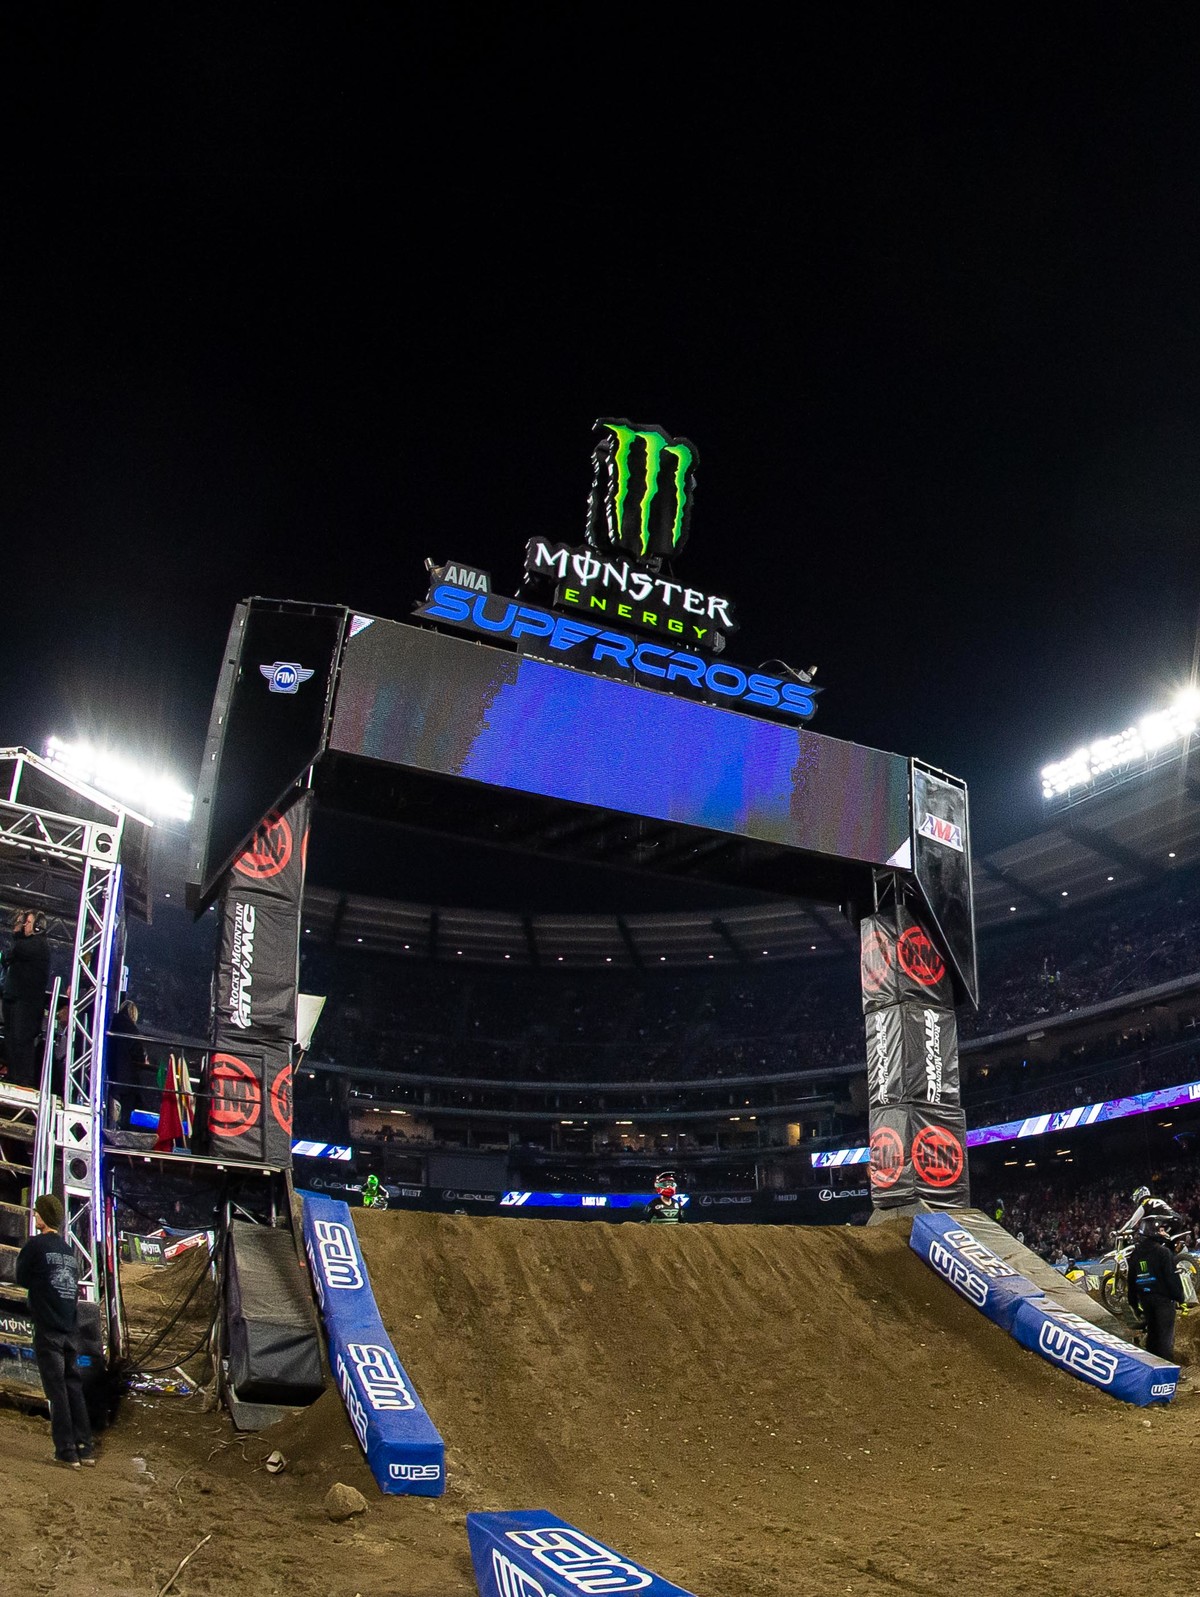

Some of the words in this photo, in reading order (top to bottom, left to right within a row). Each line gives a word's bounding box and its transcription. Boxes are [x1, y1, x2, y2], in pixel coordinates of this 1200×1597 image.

[444, 566, 489, 593] AMA
[534, 541, 734, 627] MONSTER
[564, 588, 708, 639] ENERGY
[425, 584, 818, 717] SUPERCROSS
[276, 671, 295, 684] FIM
[920, 815, 962, 849] AMA
[231, 902, 243, 968] MOUNTAIN
[229, 967, 241, 1009] ROCKY
[456, 1193, 496, 1202] LEXUS
[832, 1188, 869, 1199] LEXUS
[314, 1219, 364, 1290] WPS
[929, 1240, 989, 1307] WPS
[347, 1343, 416, 1410] WPS
[1039, 1320, 1119, 1385] WPS
[1150, 1382, 1176, 1397] WPS
[389, 1463, 440, 1481] WPS
[505, 1527, 654, 1594] WPS
